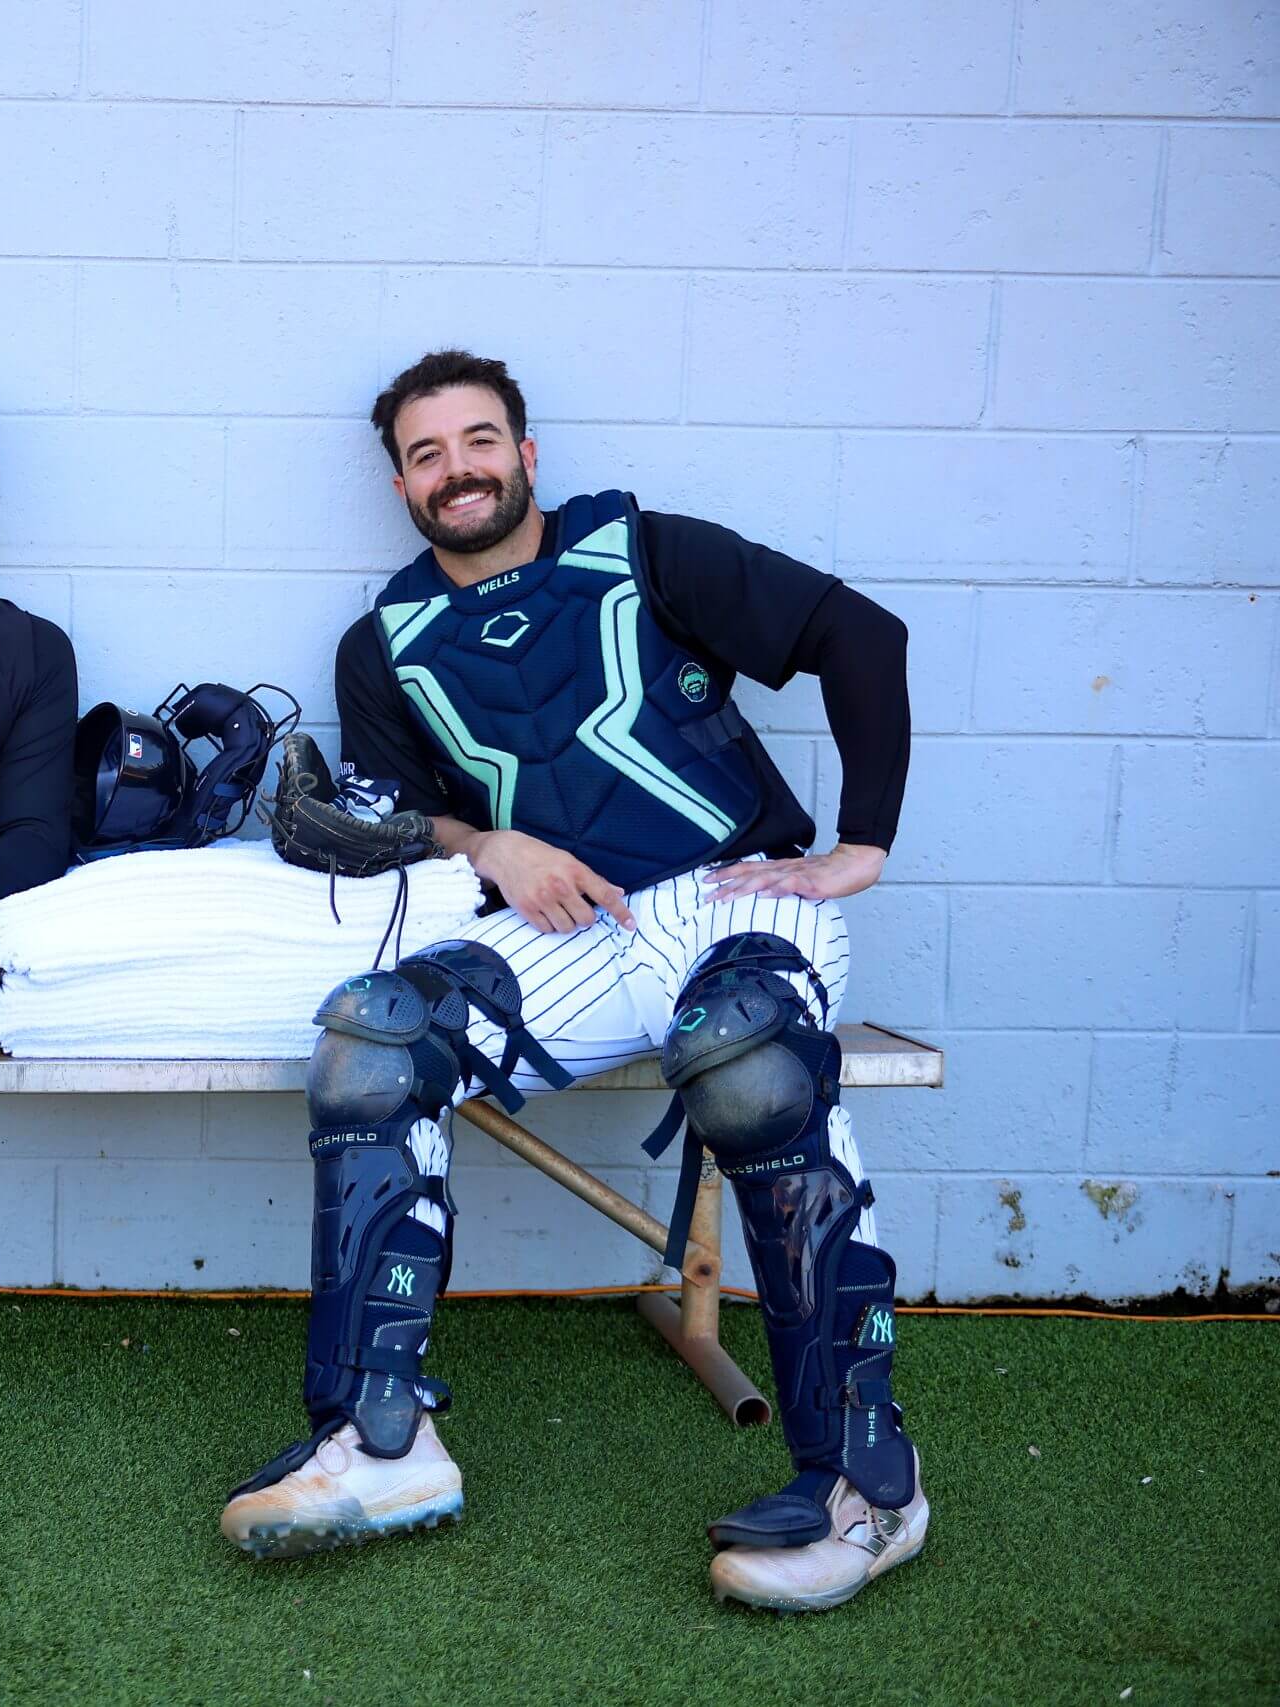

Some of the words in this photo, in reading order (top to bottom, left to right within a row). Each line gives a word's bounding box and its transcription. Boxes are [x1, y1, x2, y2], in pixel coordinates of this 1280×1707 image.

[477, 571, 520, 596] WELLS
[387, 1263, 416, 1297] NY
[871, 1310, 893, 1344] NY
